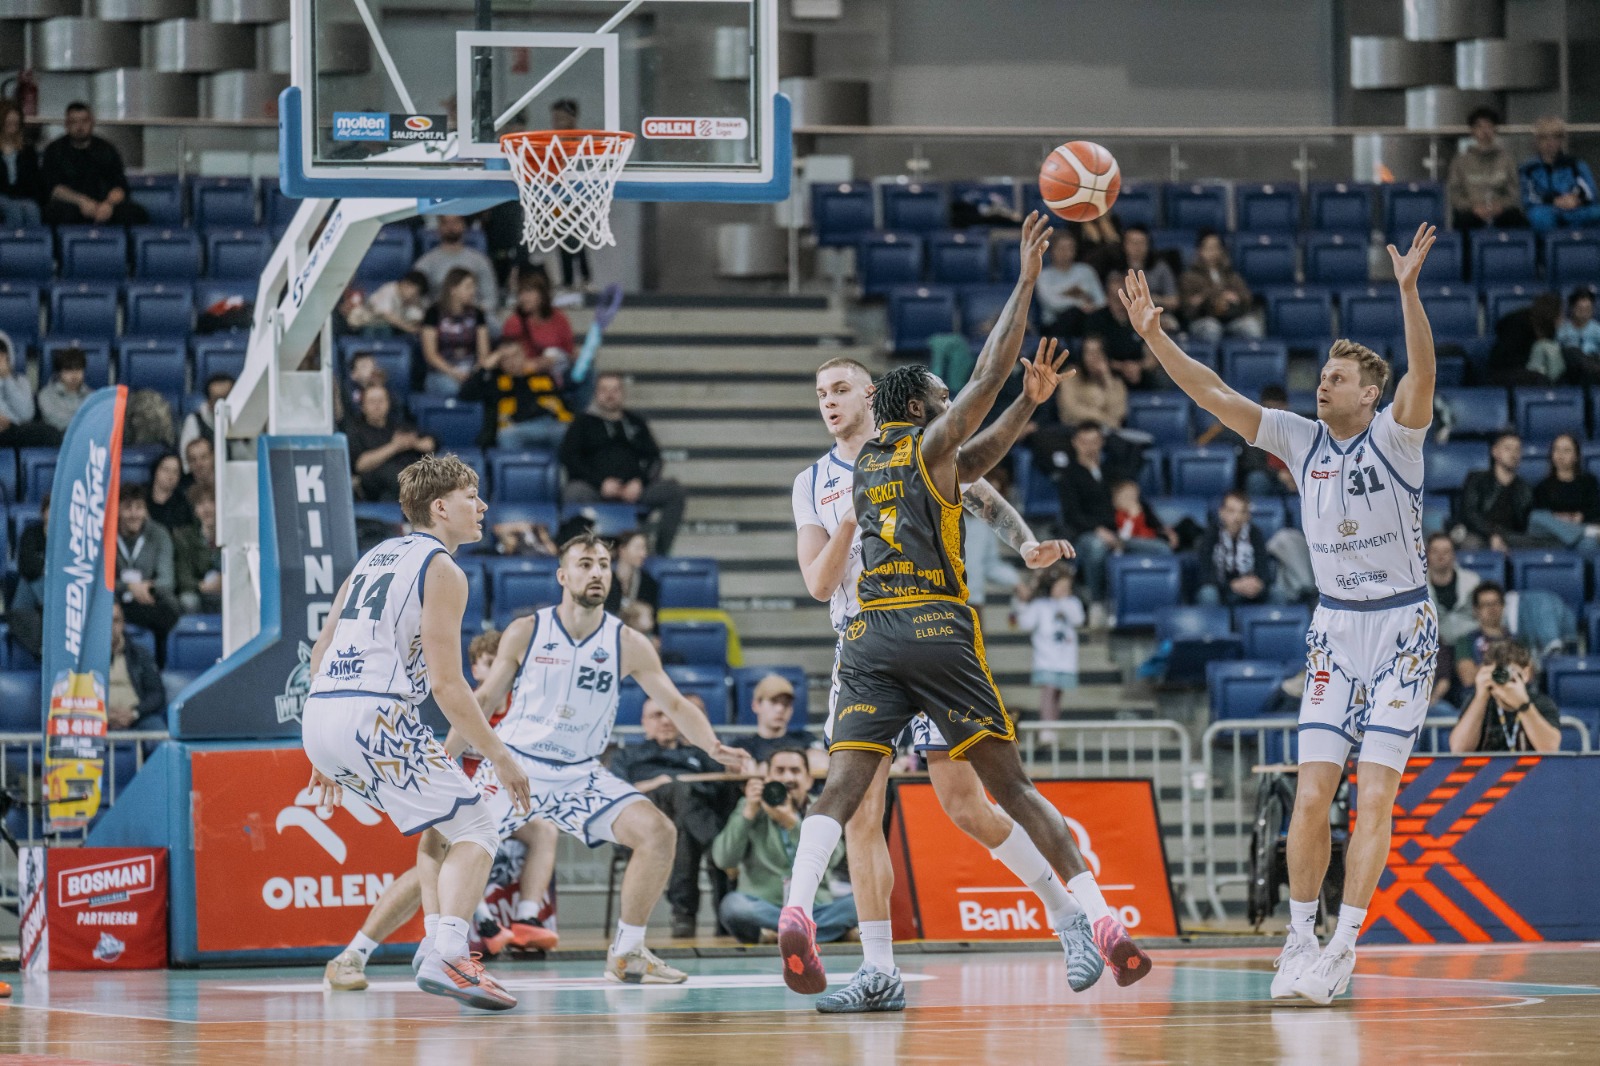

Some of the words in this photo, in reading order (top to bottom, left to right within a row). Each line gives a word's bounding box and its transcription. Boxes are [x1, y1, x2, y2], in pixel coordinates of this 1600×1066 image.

[337, 116, 385, 129] molten
[646, 122, 693, 134] ORLEN
[1347, 464, 1386, 496] 31
[295, 465, 334, 642] KING
[1312, 542, 1329, 554] KING
[1329, 530, 1399, 554] APARTAMENTY
[1367, 572, 1388, 582] 2050
[339, 572, 396, 621] 14
[65, 583, 84, 657] HED
[330, 659, 365, 676] KING
[577, 665, 613, 694] 28
[67, 863, 146, 897] BOSMAN
[262, 873, 394, 910] ORLEN
[76, 911, 138, 926] PARTNEREM
[958, 899, 1041, 932] Bank
